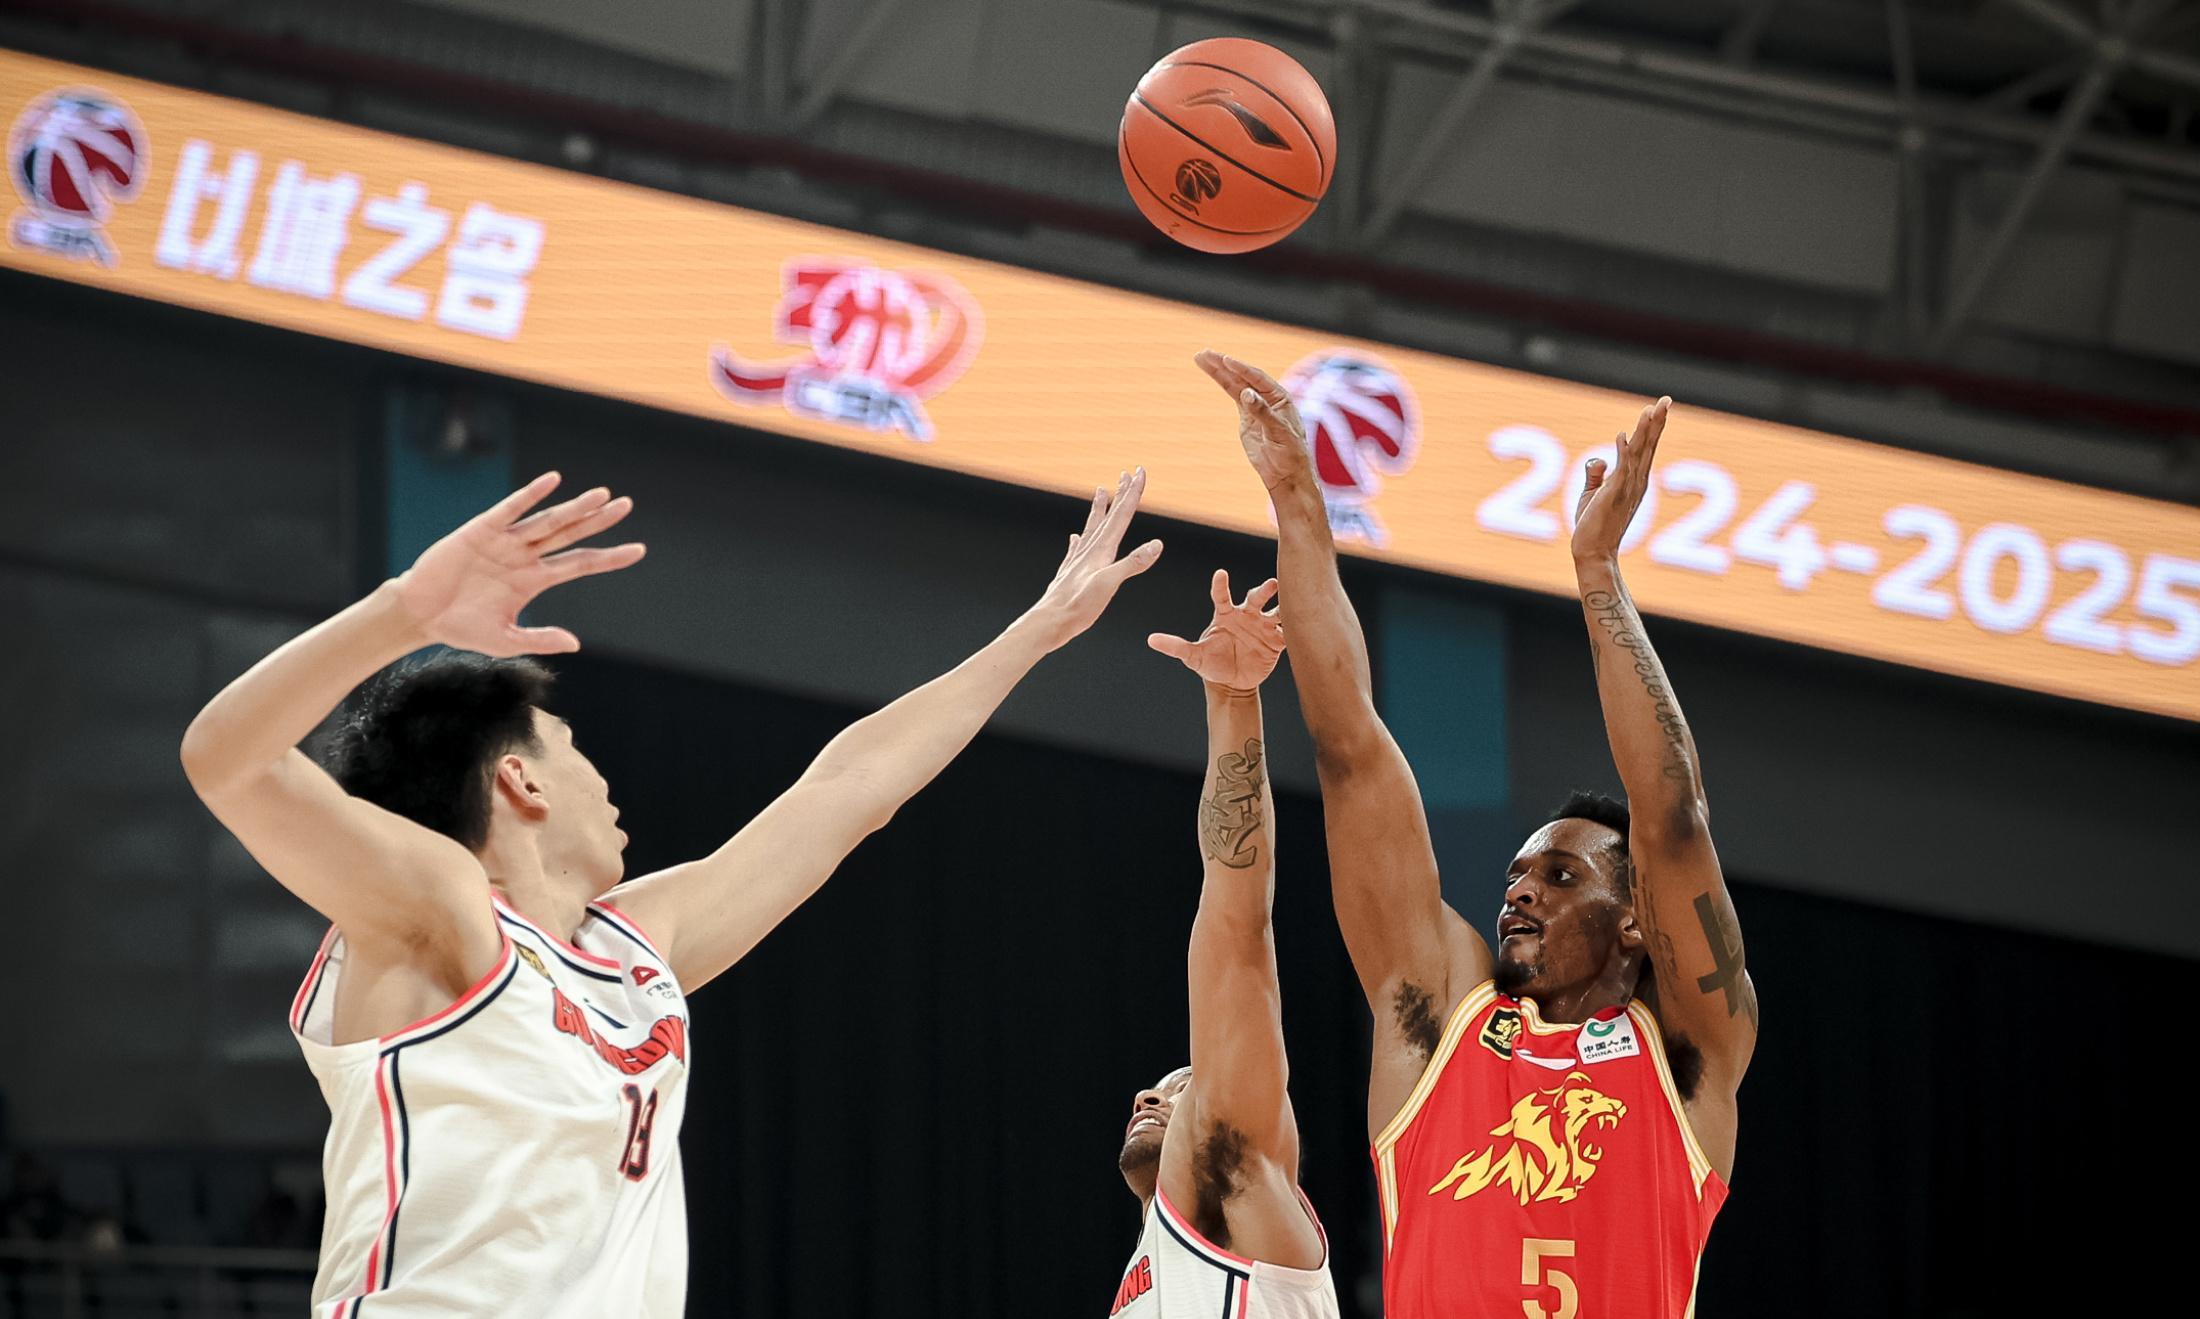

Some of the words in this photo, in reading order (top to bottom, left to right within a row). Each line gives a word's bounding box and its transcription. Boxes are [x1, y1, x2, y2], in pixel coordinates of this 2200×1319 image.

[1585, 1049, 1613, 1060] CHINA
[1614, 1044, 1633, 1053] LIFE
[1521, 1237, 1579, 1319] 5
